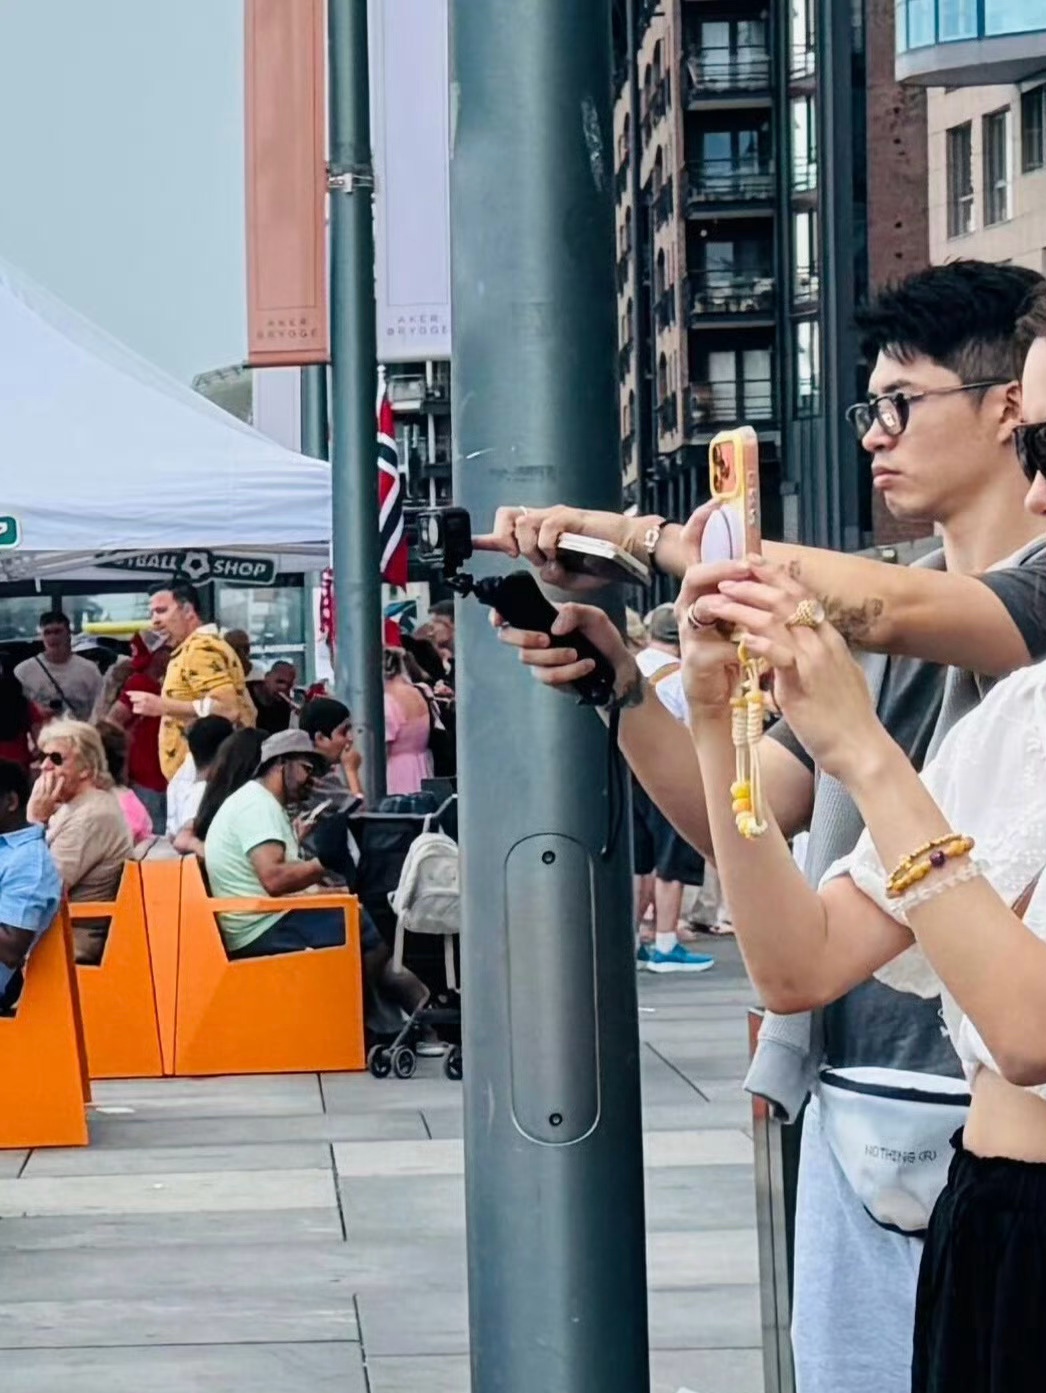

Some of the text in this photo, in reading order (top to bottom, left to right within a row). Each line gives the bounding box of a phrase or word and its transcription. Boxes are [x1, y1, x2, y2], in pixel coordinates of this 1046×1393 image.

[267, 317, 307, 327] AKER
[398, 314, 439, 324] AKER
[257, 328, 317, 339] BRYGGE
[387, 326, 449, 337] BRYGGE
[213, 559, 267, 577] SHOP
